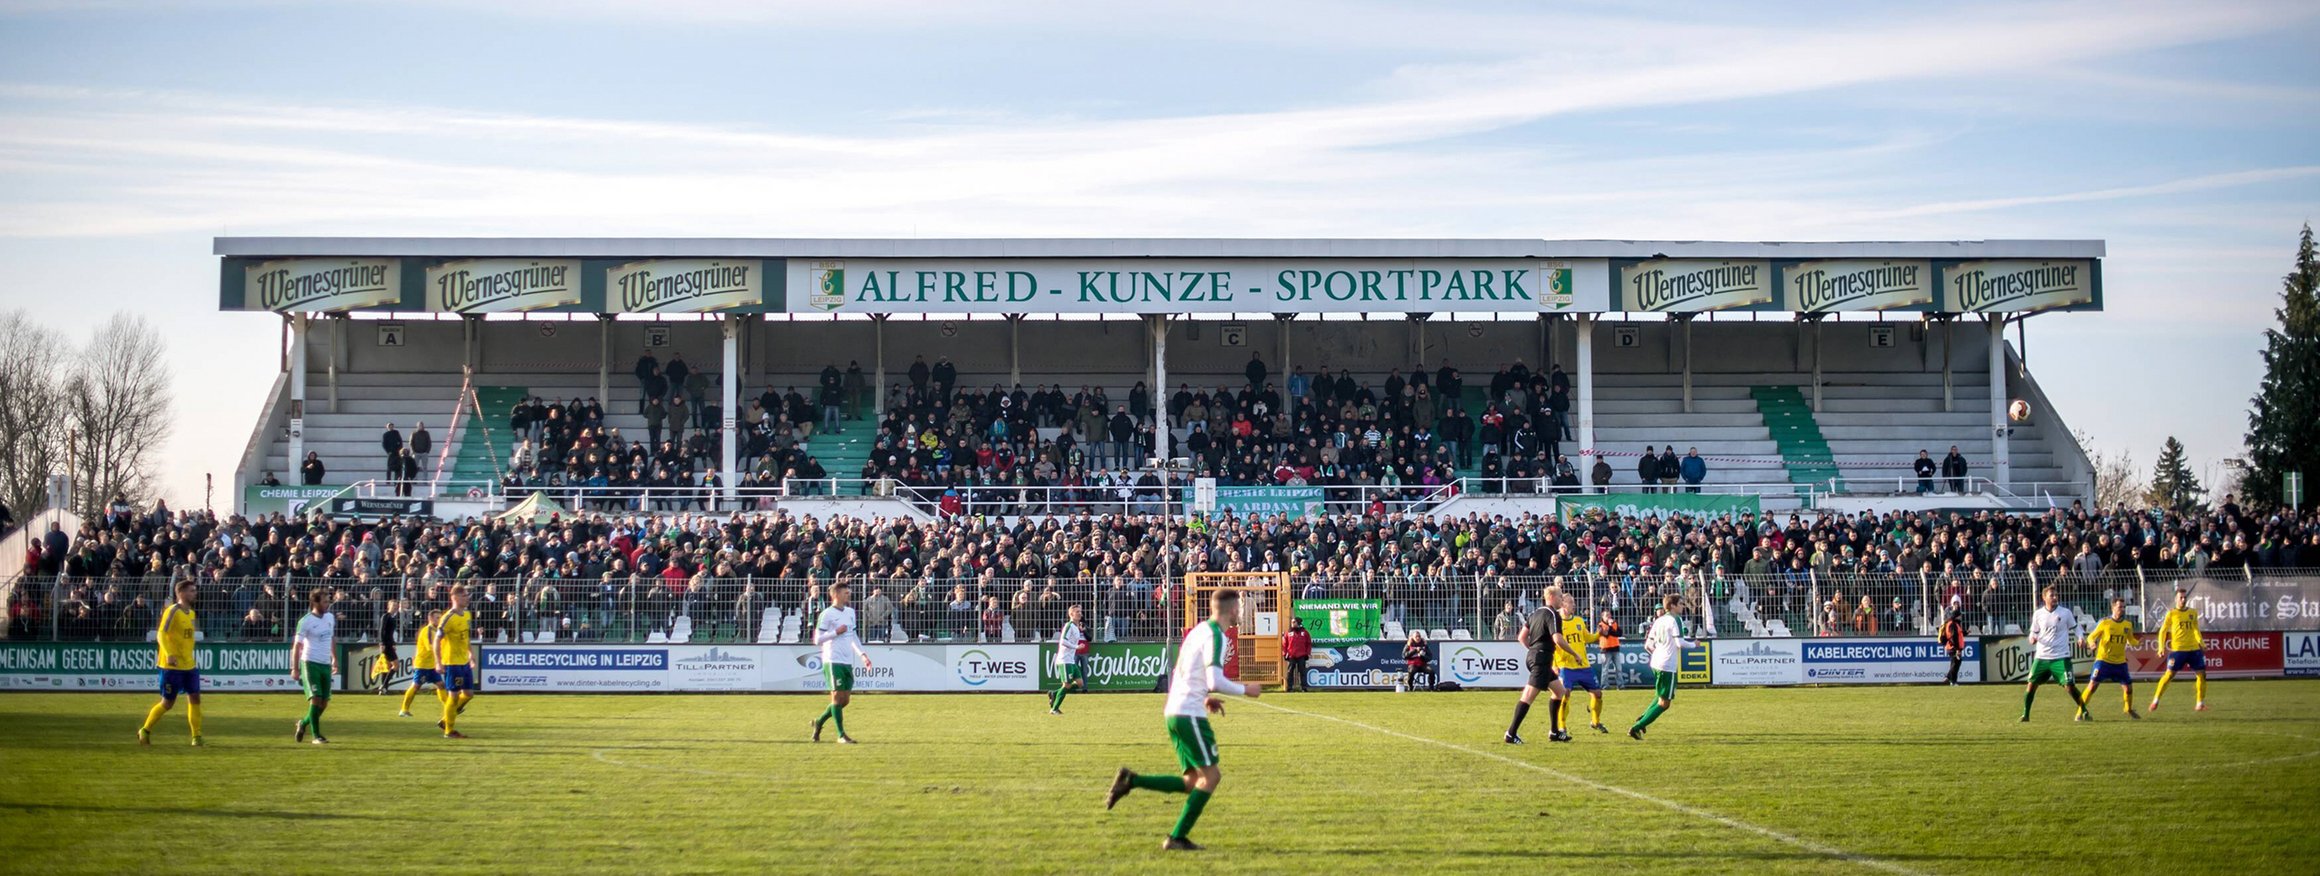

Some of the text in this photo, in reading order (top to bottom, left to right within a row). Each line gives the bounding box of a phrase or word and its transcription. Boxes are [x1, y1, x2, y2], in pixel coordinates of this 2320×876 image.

[257, 261, 387, 311] Wernesgrüner
[438, 261, 568, 312] Wernesgrüner
[618, 262, 749, 312] Wernesgrüner
[855, 270, 1037, 303] ALFRED
[1076, 270, 1234, 303] KUNZE
[1276, 269, 1532, 301] SPORTPARK
[1633, 261, 1758, 311] Wernesgrüner
[1795, 261, 1919, 311] Wernesgrüner
[1954, 261, 2078, 311] Wernesgrüner
[385, 333, 397, 344] A
[653, 334, 662, 345] B
[1228, 333, 1239, 345] C
[1622, 335, 1633, 346] D
[1878, 334, 1888, 346] E
[260, 489, 339, 498] CHEMIE LEIPZIG
[1270, 488, 1322, 497] LEIPZIG
[1242, 502, 1300, 511] ARDANA
[2223, 636, 2270, 650] KÜHNE
[2285, 635, 2320, 657] LA
[62, 648, 104, 669] GEGEN
[1807, 646, 1912, 659] KABELRECYCLING
[1915, 646, 1927, 658] IN
[488, 653, 663, 666] KABELRECYCLING IN LEIPZIG
[1462, 658, 1519, 671] T-WES
[852, 667, 895, 678] ORUPPA
[968, 661, 1027, 674] T-WES
[1817, 668, 1865, 676] DINTER
[496, 675, 548, 683] DINTER
[556, 679, 661, 687] www.dinter-kabelrecycling.de
[875, 680, 895, 688] GmbH
